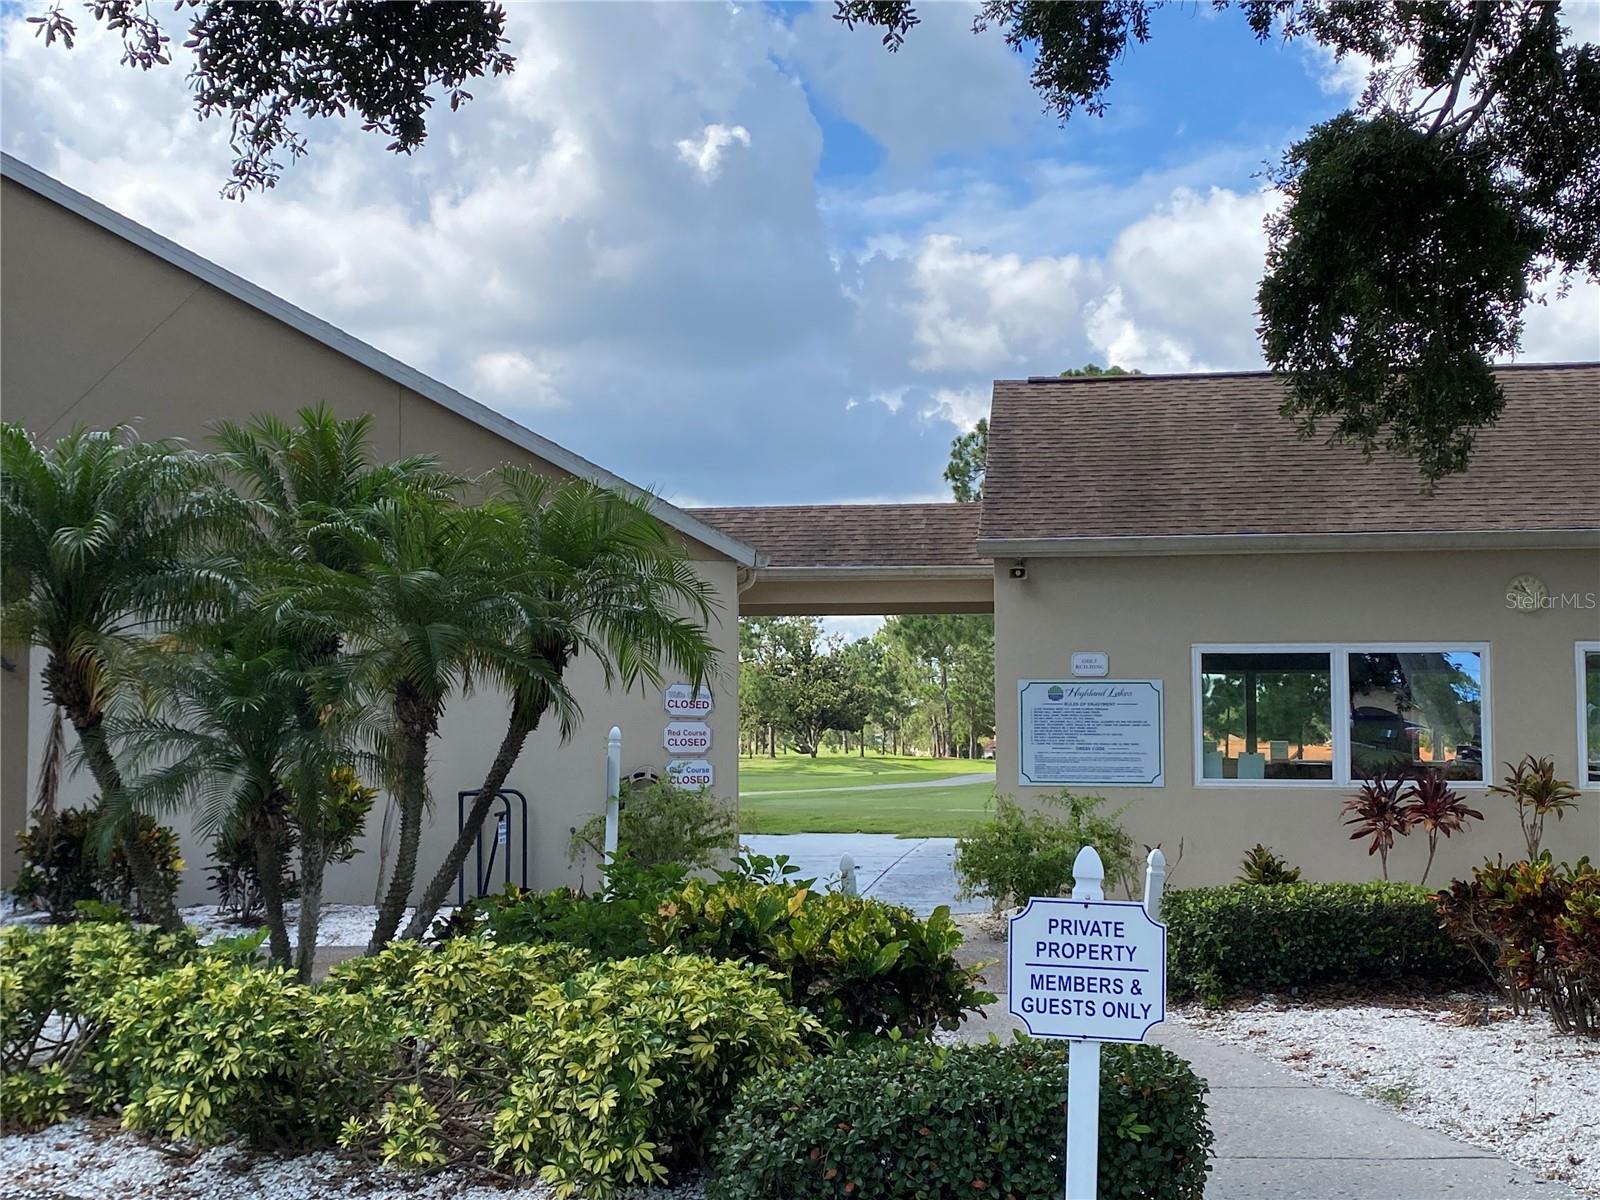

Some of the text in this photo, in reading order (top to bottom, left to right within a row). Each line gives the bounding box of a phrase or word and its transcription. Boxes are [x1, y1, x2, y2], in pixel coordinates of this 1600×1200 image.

[1065, 686, 1133, 700] Highland Lakes
[667, 699, 710, 710] CLOSED
[667, 729, 707, 737] Red Course
[667, 738, 707, 747] CLOSED
[686, 766, 710, 774] Course
[669, 775, 710, 785] CLOSED
[1048, 918, 1125, 938] PRIVATE
[1036, 941, 1137, 962] PROPERTY
[1030, 973, 1143, 996] MEMBERS &
[1021, 996, 1152, 1020] GUESTS ONLY
